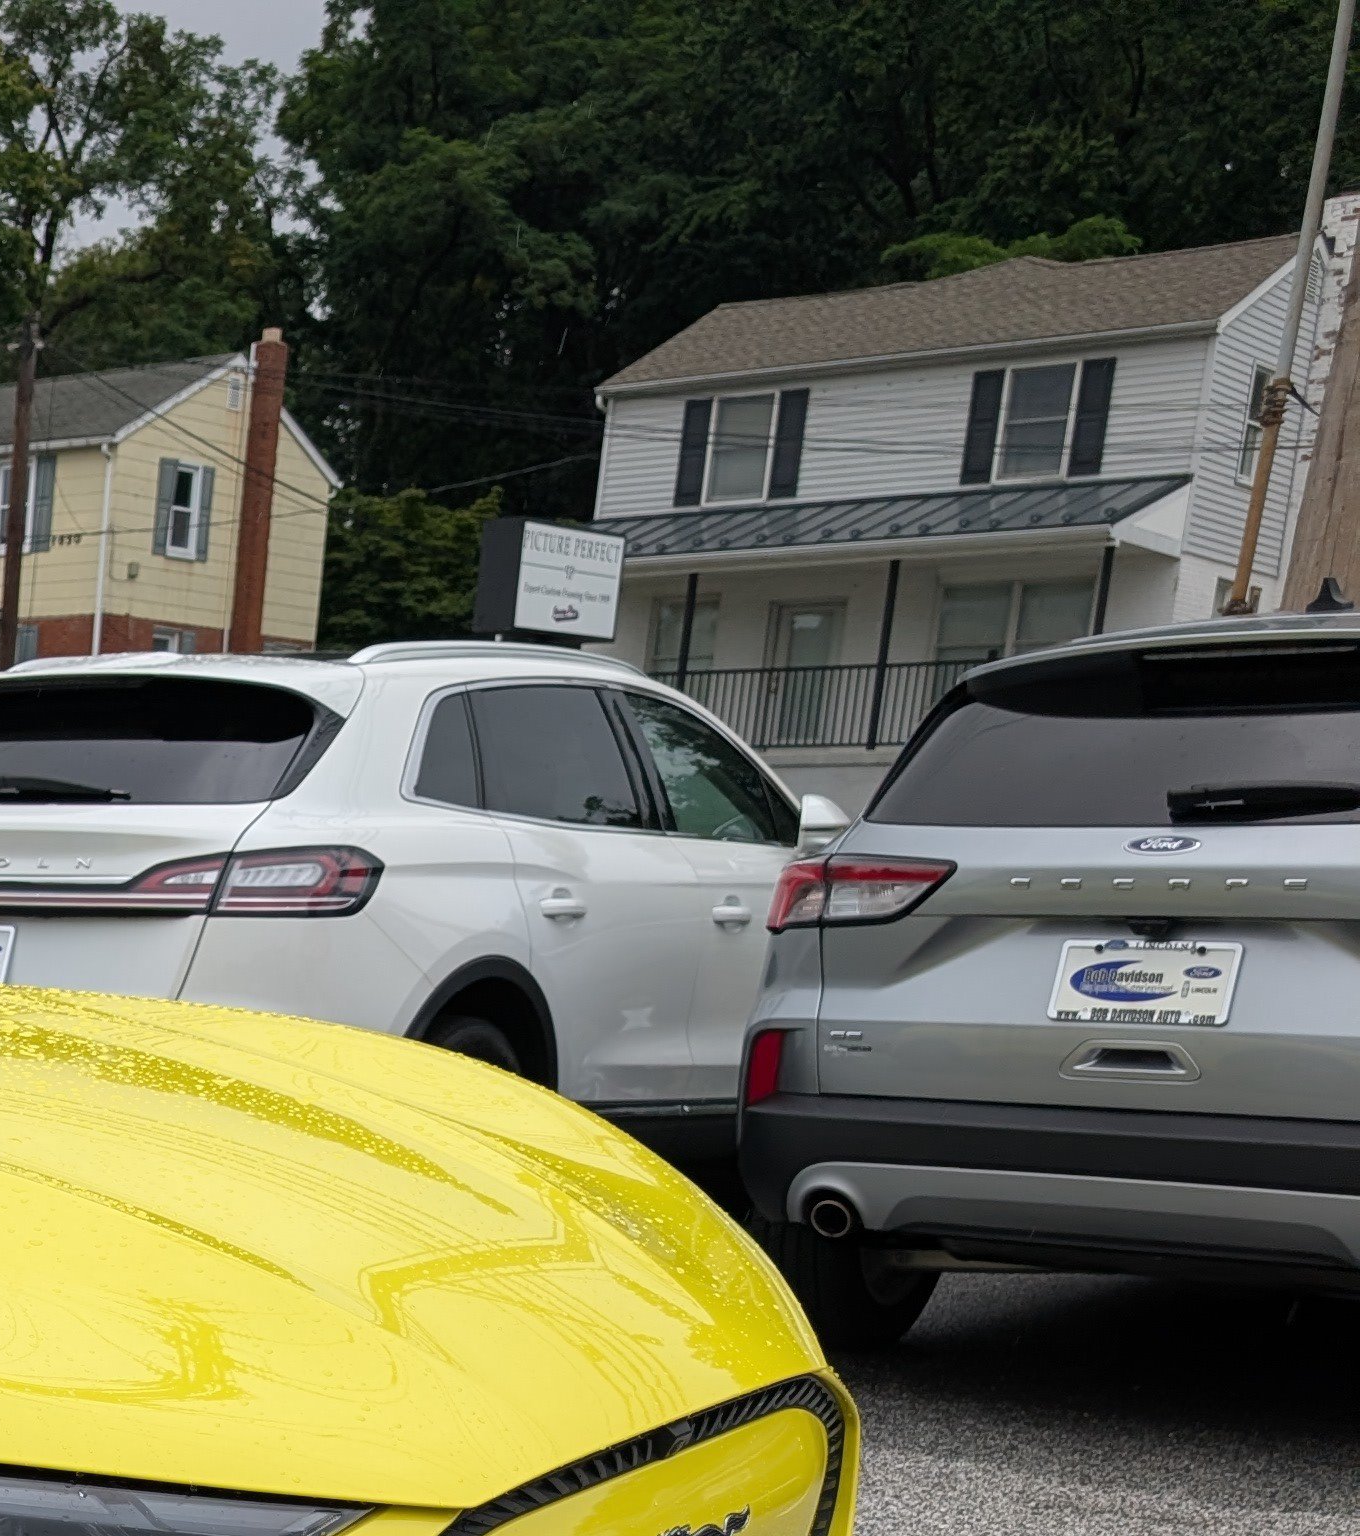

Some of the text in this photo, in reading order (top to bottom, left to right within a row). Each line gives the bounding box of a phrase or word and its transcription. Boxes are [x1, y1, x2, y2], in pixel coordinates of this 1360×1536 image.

[523, 530, 620, 563] PICTURE PERFECT
[1084, 967, 1164, 983] Bob Davidson
[1091, 1007, 1109, 1021] BOB
[1111, 1008, 1155, 1023] DAVIDSON
[1156, 1010, 1182, 1024] AUTO
